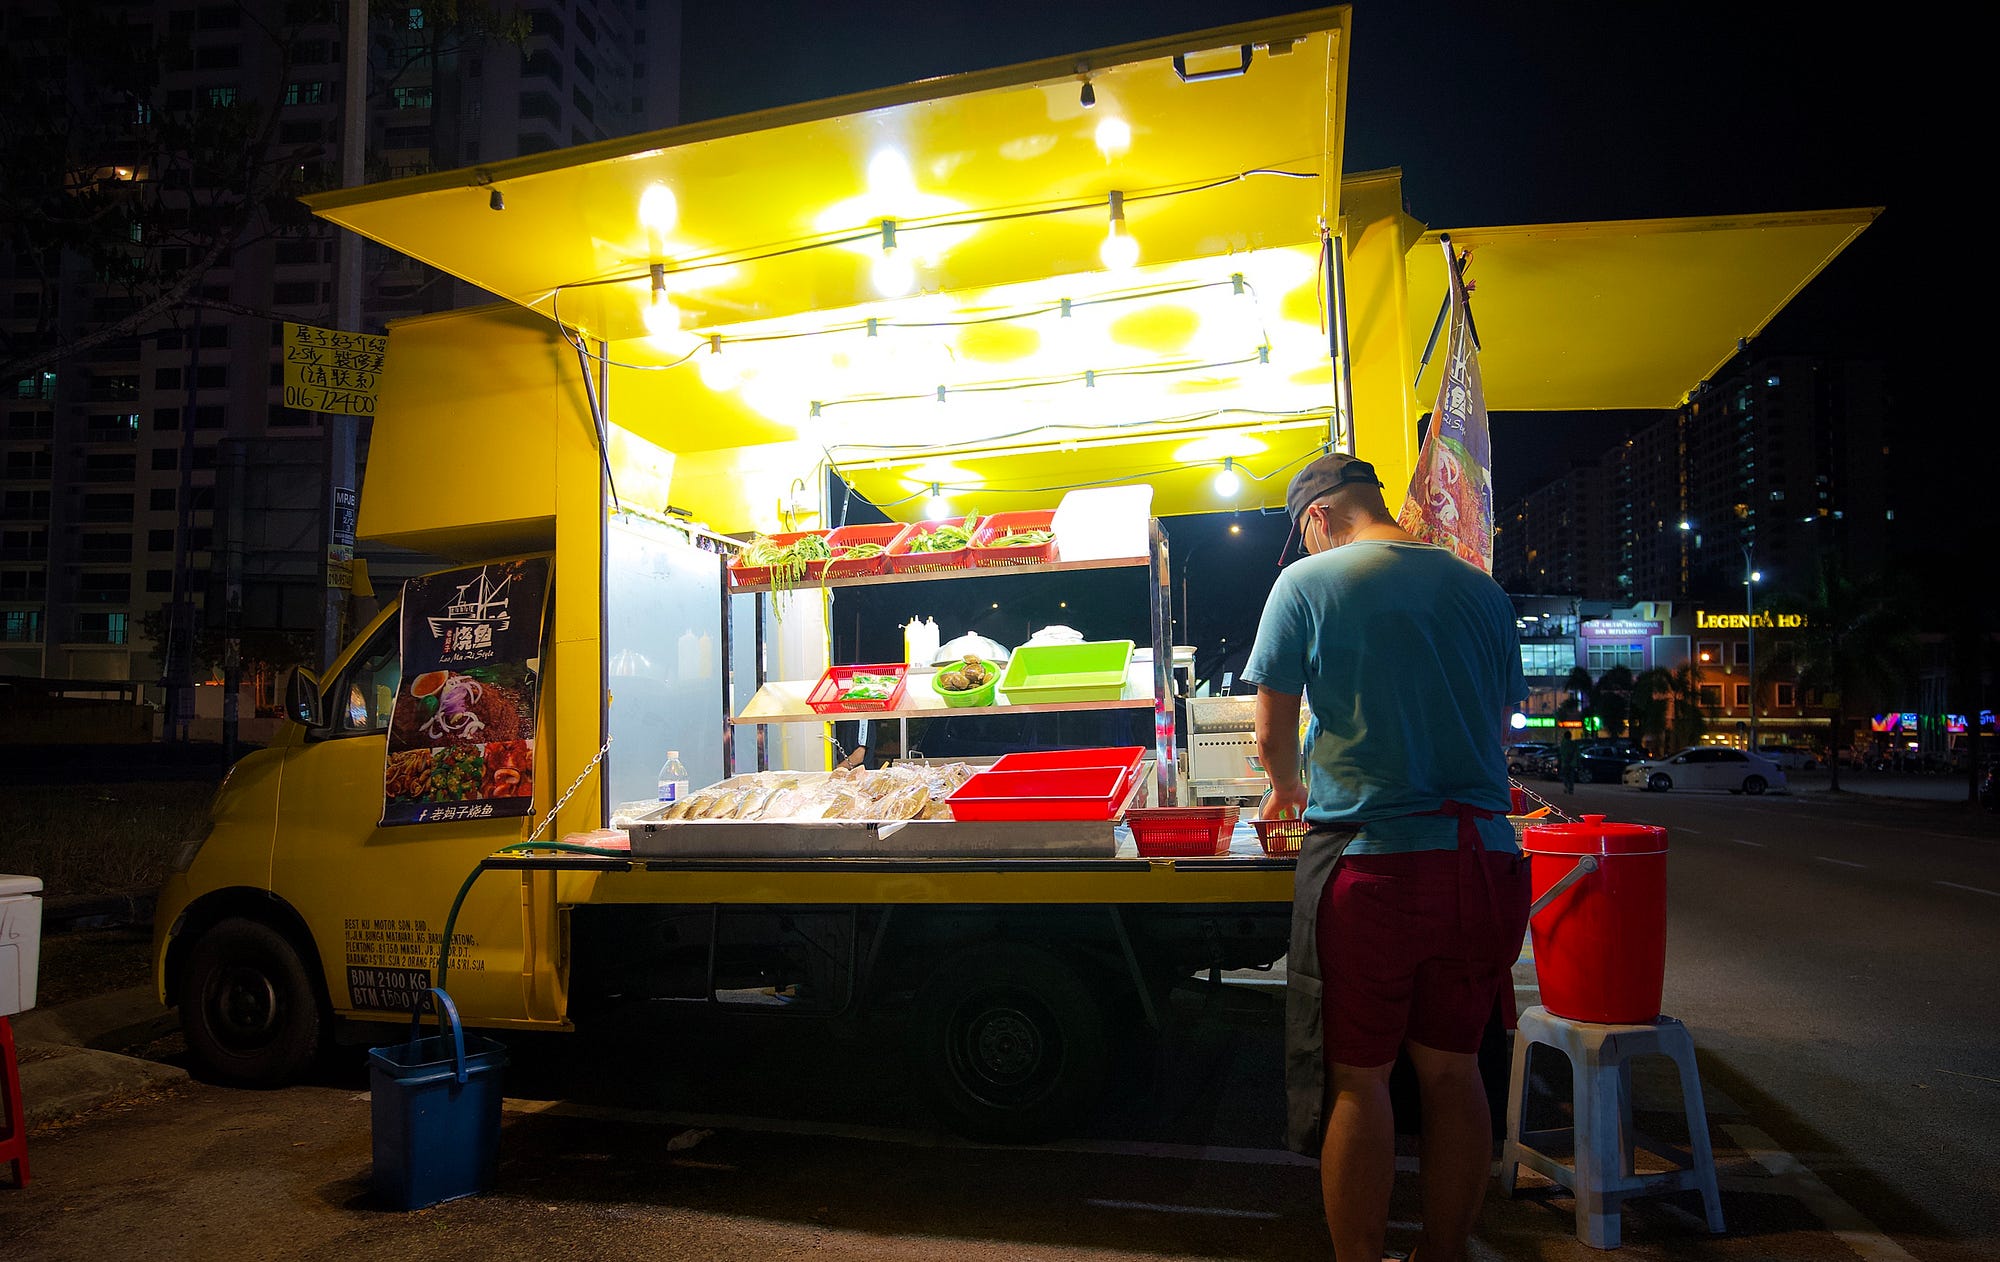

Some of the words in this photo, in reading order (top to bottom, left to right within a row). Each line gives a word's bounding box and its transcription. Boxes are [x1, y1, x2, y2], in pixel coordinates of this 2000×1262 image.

[296, 326, 386, 353] 屋子好介绍
[286, 386, 378, 413] 016-72400
[452, 624, 492, 652] 烧鱼
[450, 653, 464, 663] Ma
[474, 649, 494, 660] Style
[430, 803, 493, 821] 老妈子烧鱼
[345, 919, 358, 930] BEST
[374, 920, 395, 931] MOTOR
[408, 956, 427, 968] ORANG
[351, 969, 375, 987] BDM
[378, 971, 406, 989] 2100
[409, 973, 427, 990] KG
[354, 987, 379, 1007] BTM
